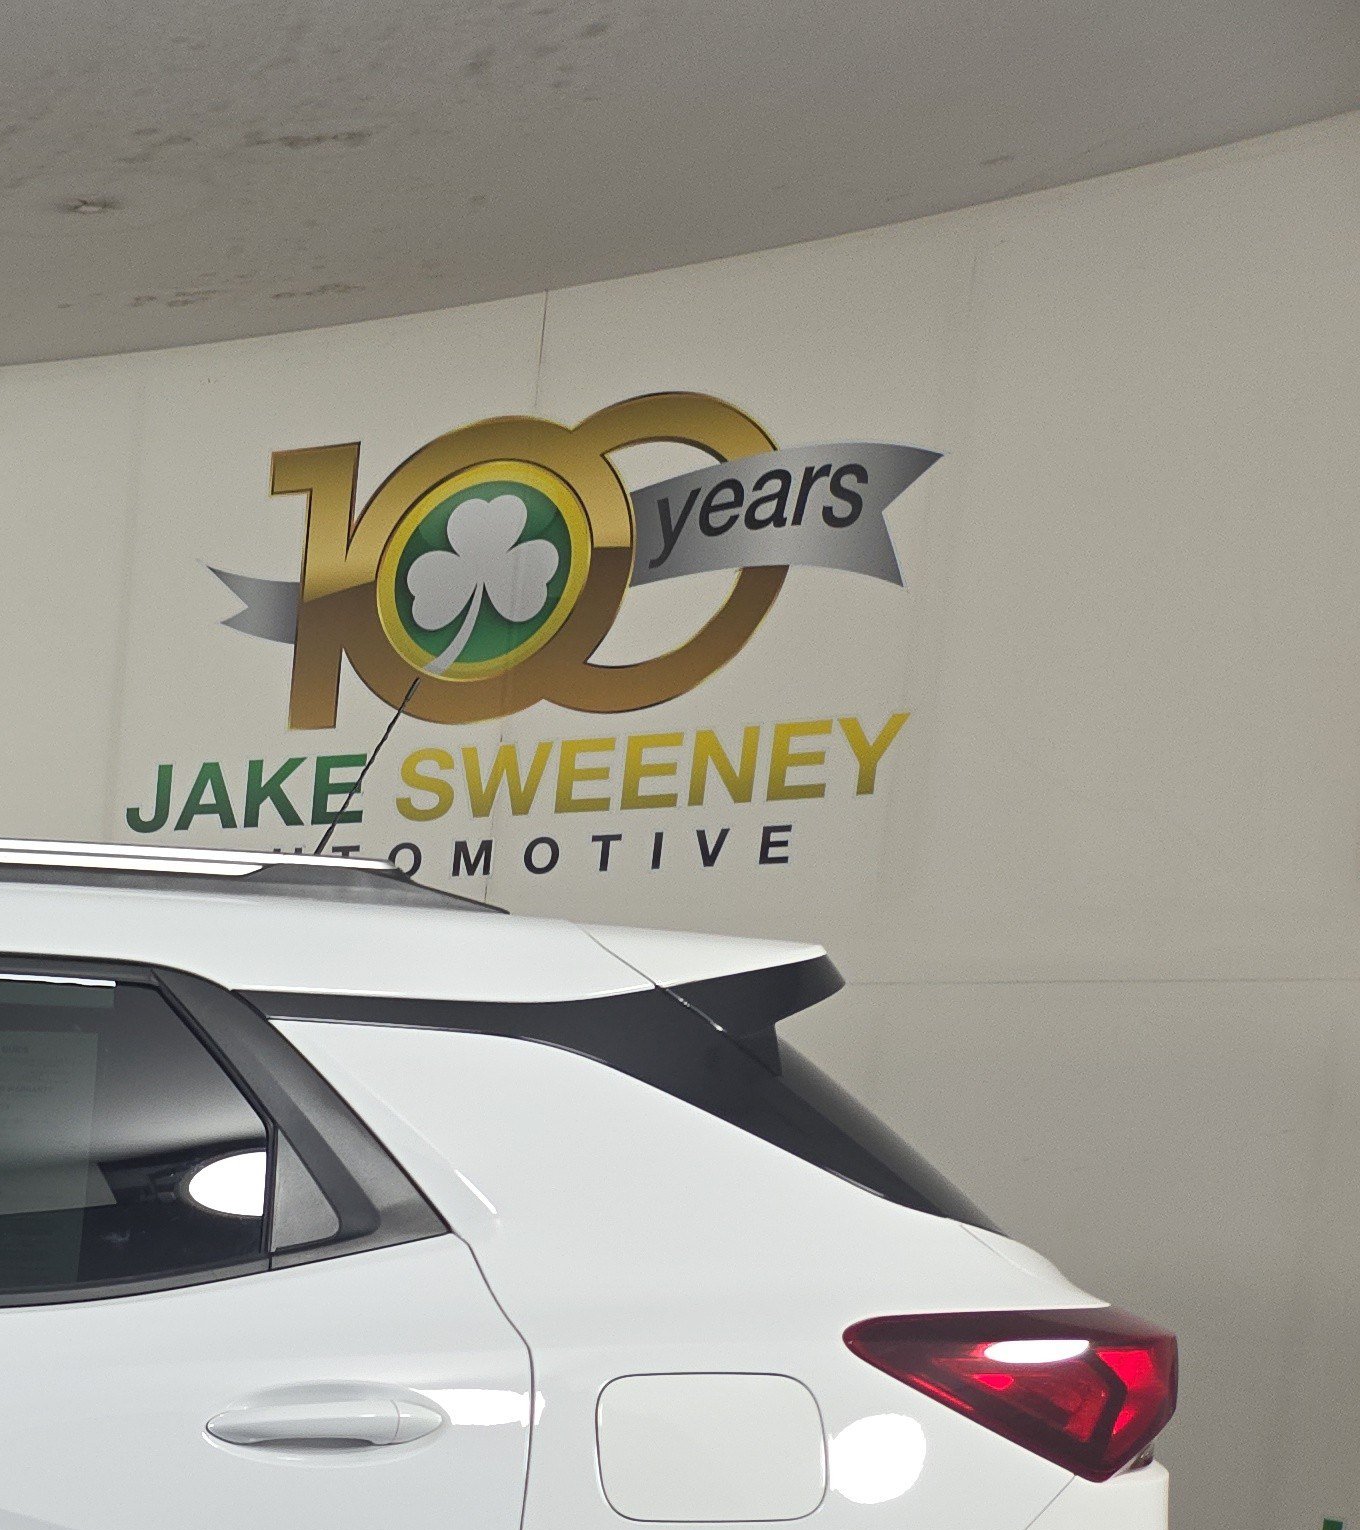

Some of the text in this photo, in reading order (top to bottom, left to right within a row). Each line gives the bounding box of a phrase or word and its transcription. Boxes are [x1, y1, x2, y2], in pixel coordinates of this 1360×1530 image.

[270, 391, 790, 730] 100
[648, 462, 869, 569] years
[126, 712, 912, 834] JAKE SWEENEY
